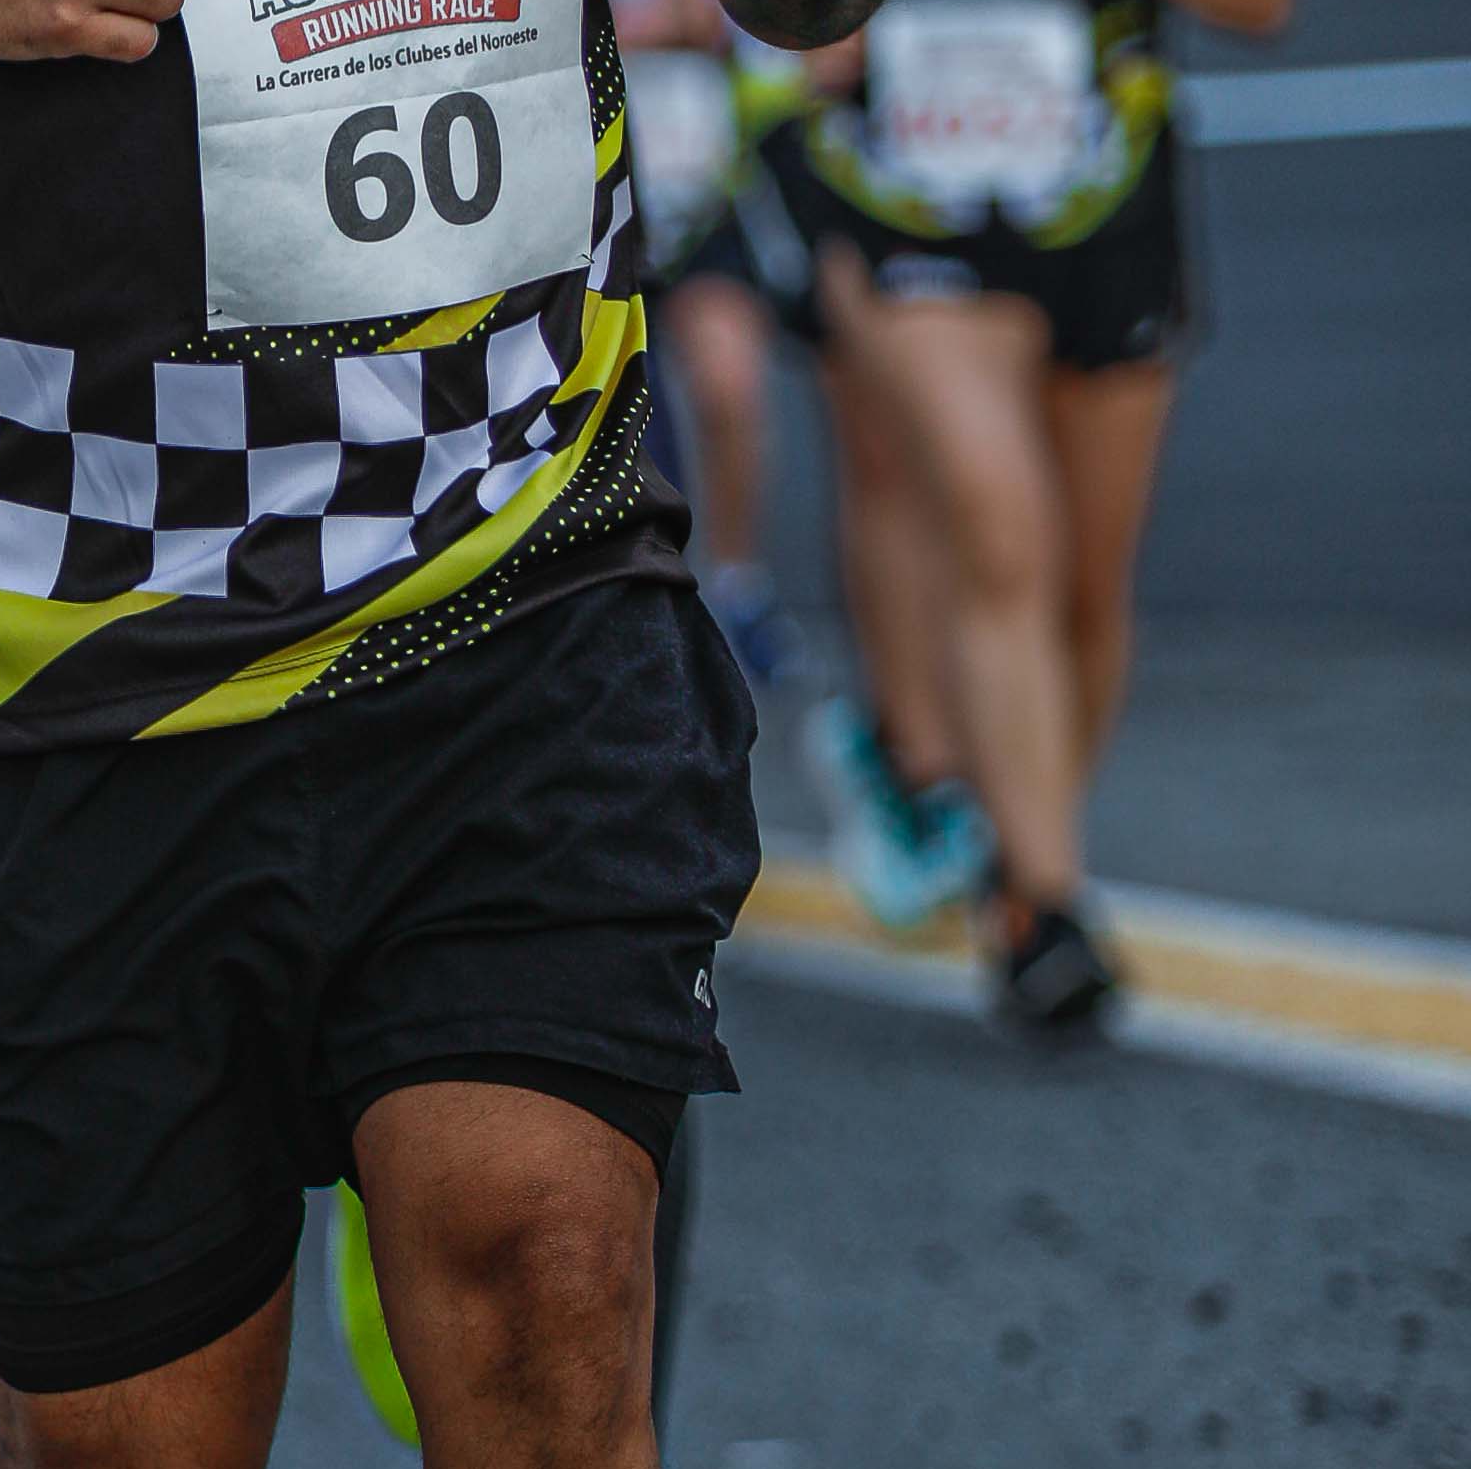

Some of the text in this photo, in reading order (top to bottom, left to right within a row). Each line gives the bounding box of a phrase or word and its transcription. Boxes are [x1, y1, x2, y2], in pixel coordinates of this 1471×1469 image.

[256, 27, 539, 92] La Carrera de los Clubes del Noroeste
[325, 91, 502, 243] 60
